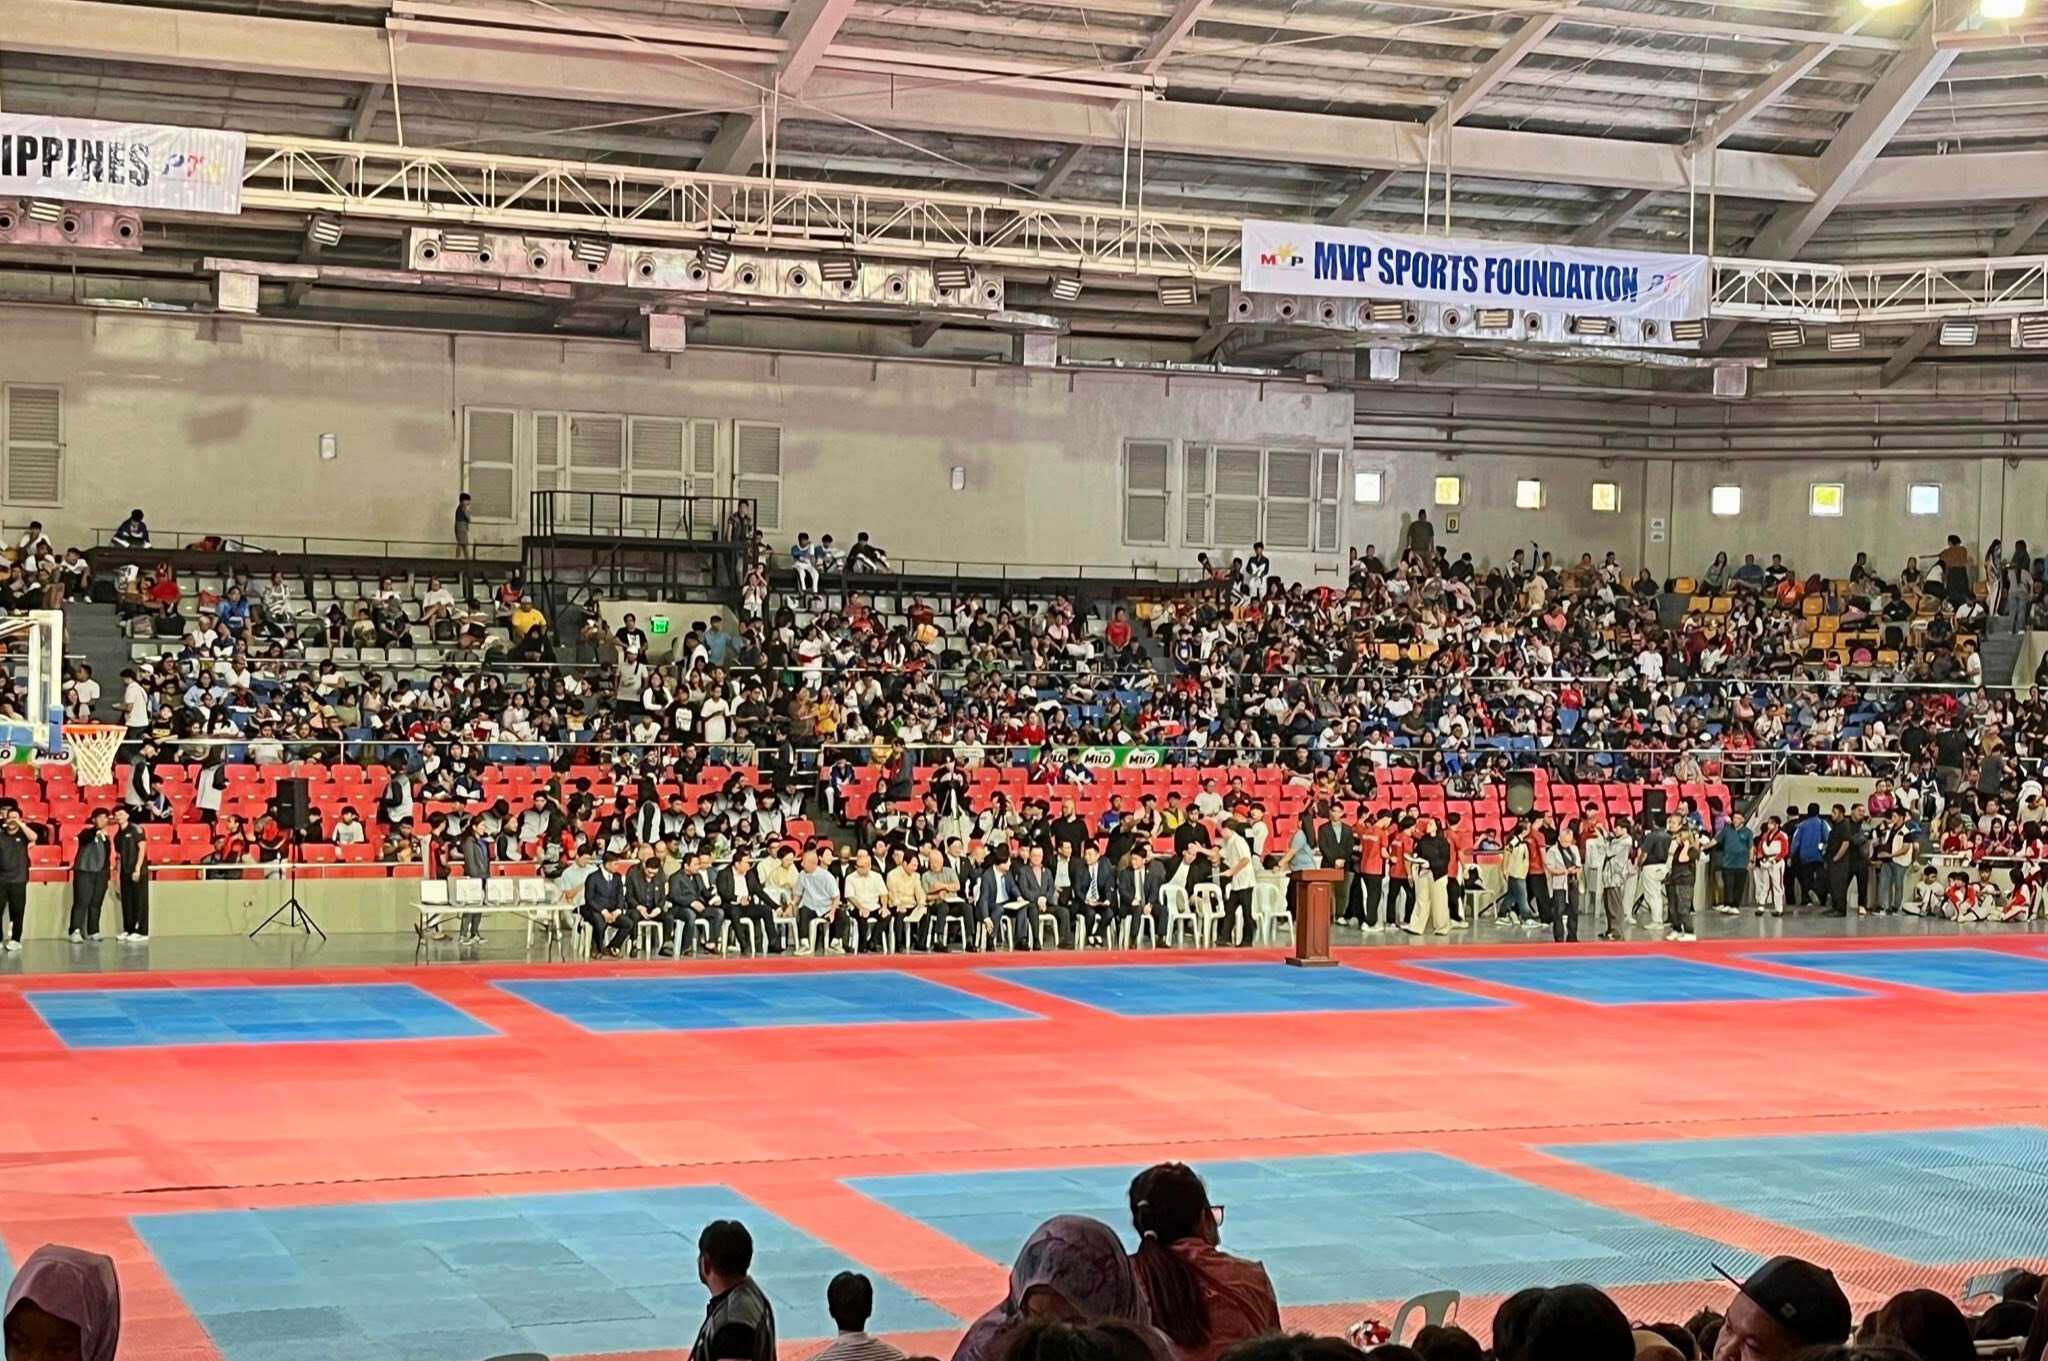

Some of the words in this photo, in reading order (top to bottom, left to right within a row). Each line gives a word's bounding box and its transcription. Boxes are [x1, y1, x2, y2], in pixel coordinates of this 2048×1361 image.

[1314, 241, 1372, 282] MVP
[1377, 247, 1479, 293] SPORTS
[1484, 257, 1639, 303] FOUNDATION
[1084, 754, 1111, 764] MILO
[1128, 755, 1155, 764] MILO
